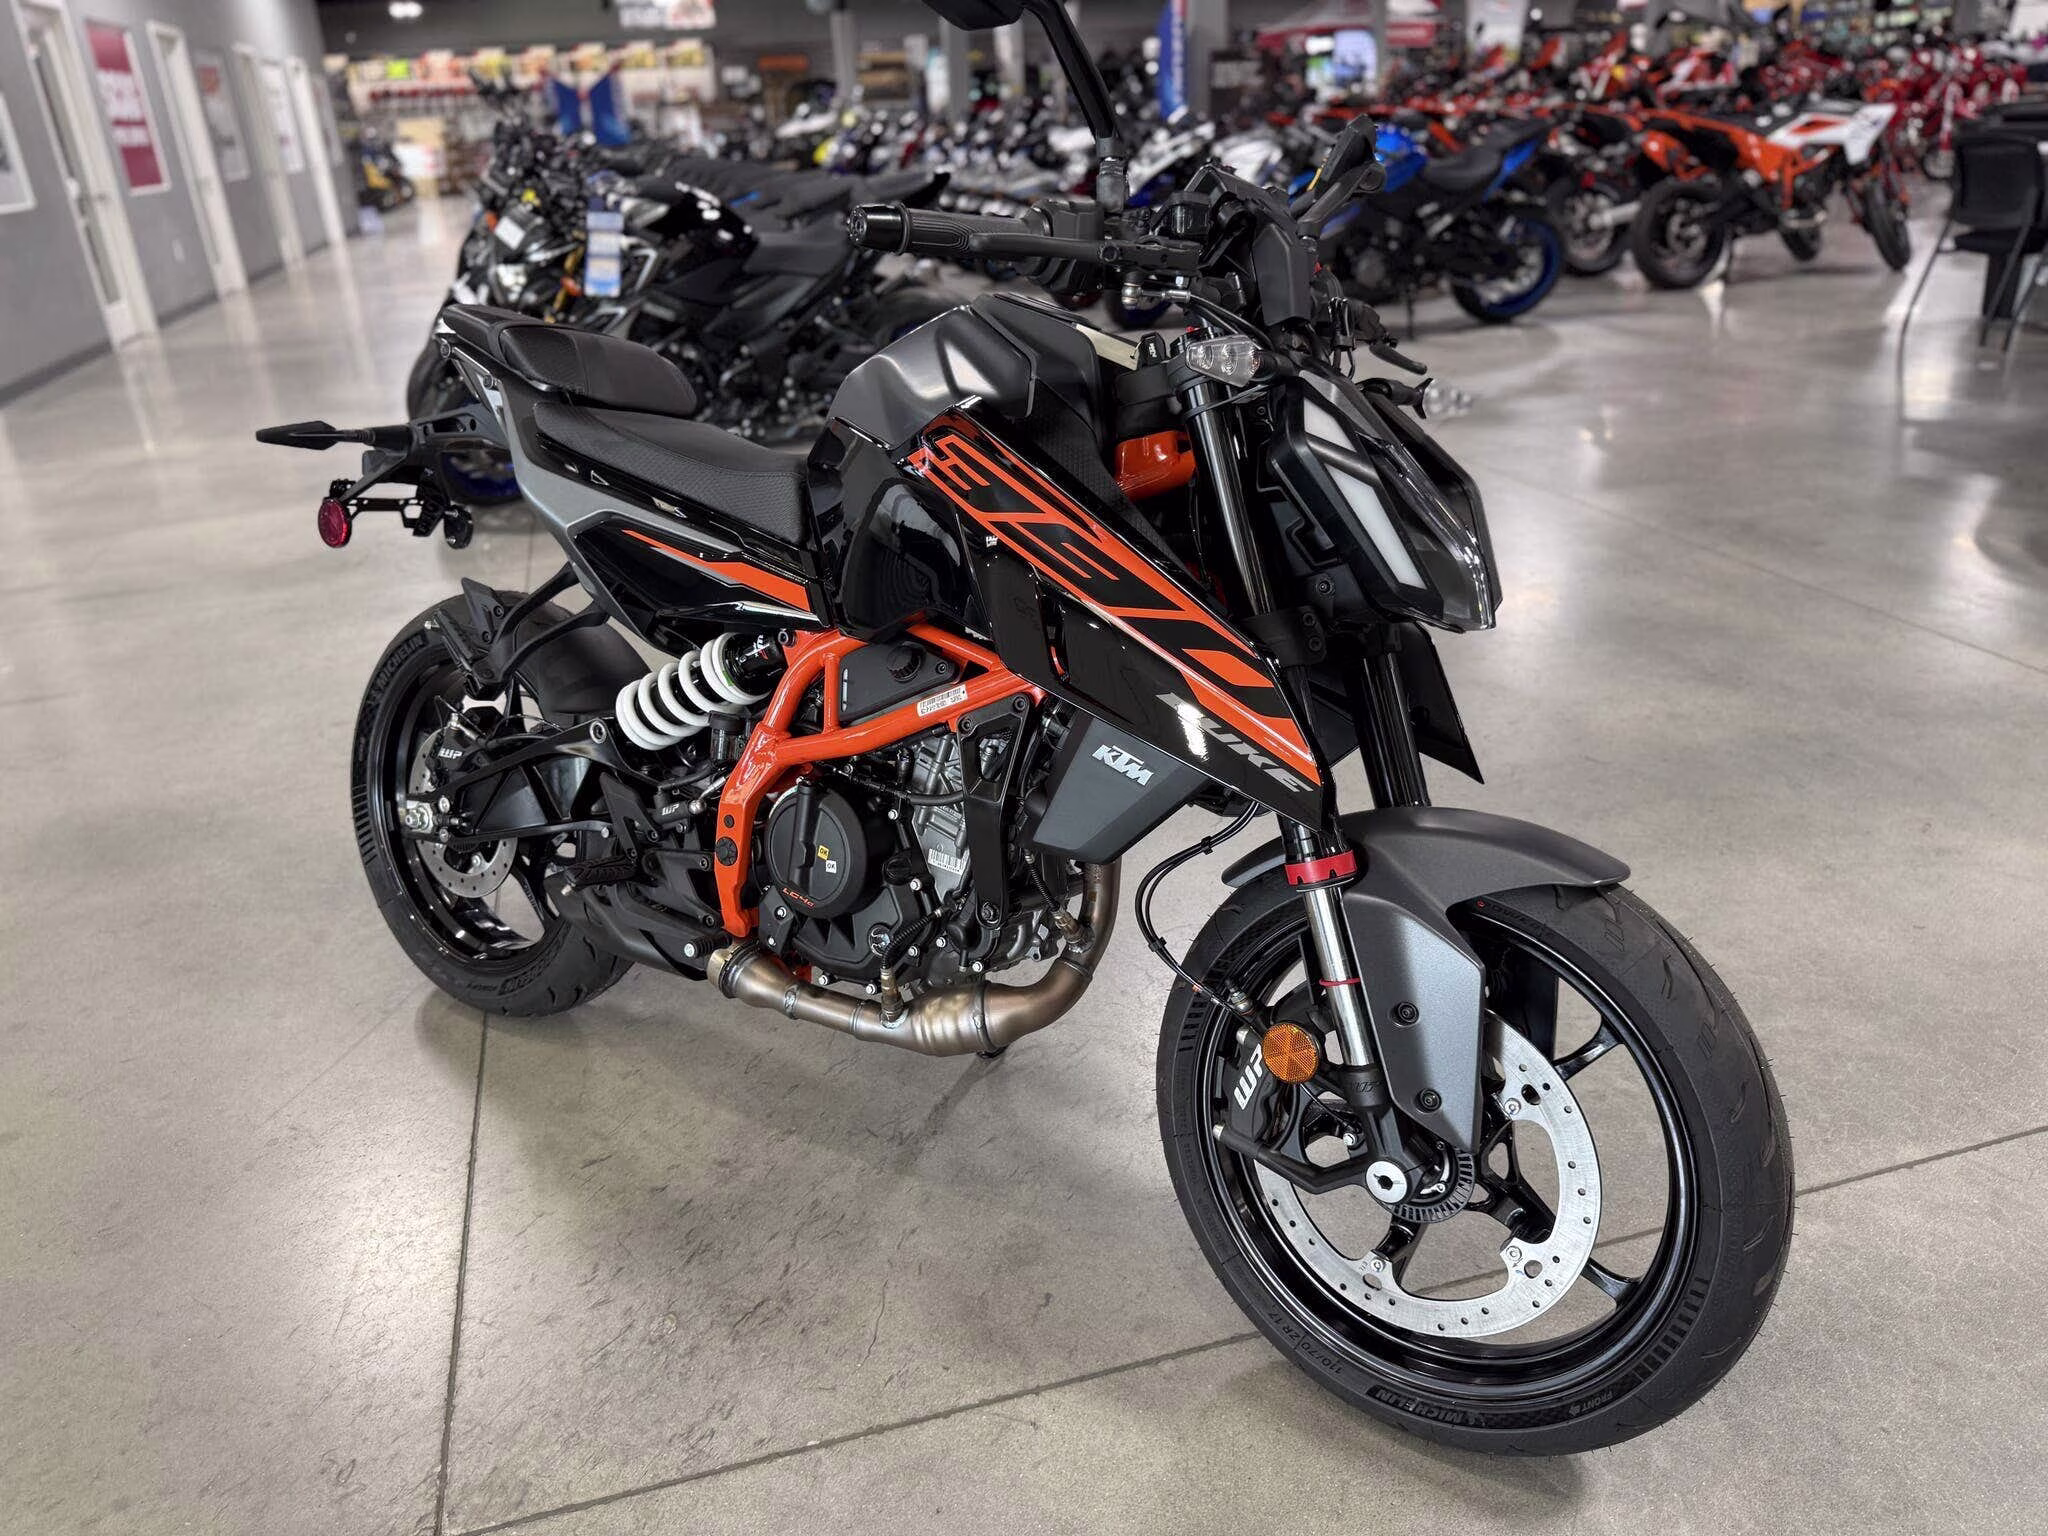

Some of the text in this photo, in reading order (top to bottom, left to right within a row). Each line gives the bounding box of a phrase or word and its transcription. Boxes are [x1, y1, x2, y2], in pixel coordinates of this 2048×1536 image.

[375, 634, 424, 694] MICHELIN
[438, 747, 463, 760] WP
[1092, 743, 1155, 786] KTM
[661, 803, 680, 816] WP
[1233, 1043, 1262, 1110] WP
[1282, 1326, 1300, 1341] ZR
[1301, 1341, 1343, 1375] 110/70
[1374, 1389, 1464, 1424] MICHELIN
[1582, 1391, 1613, 1411] FRONT
